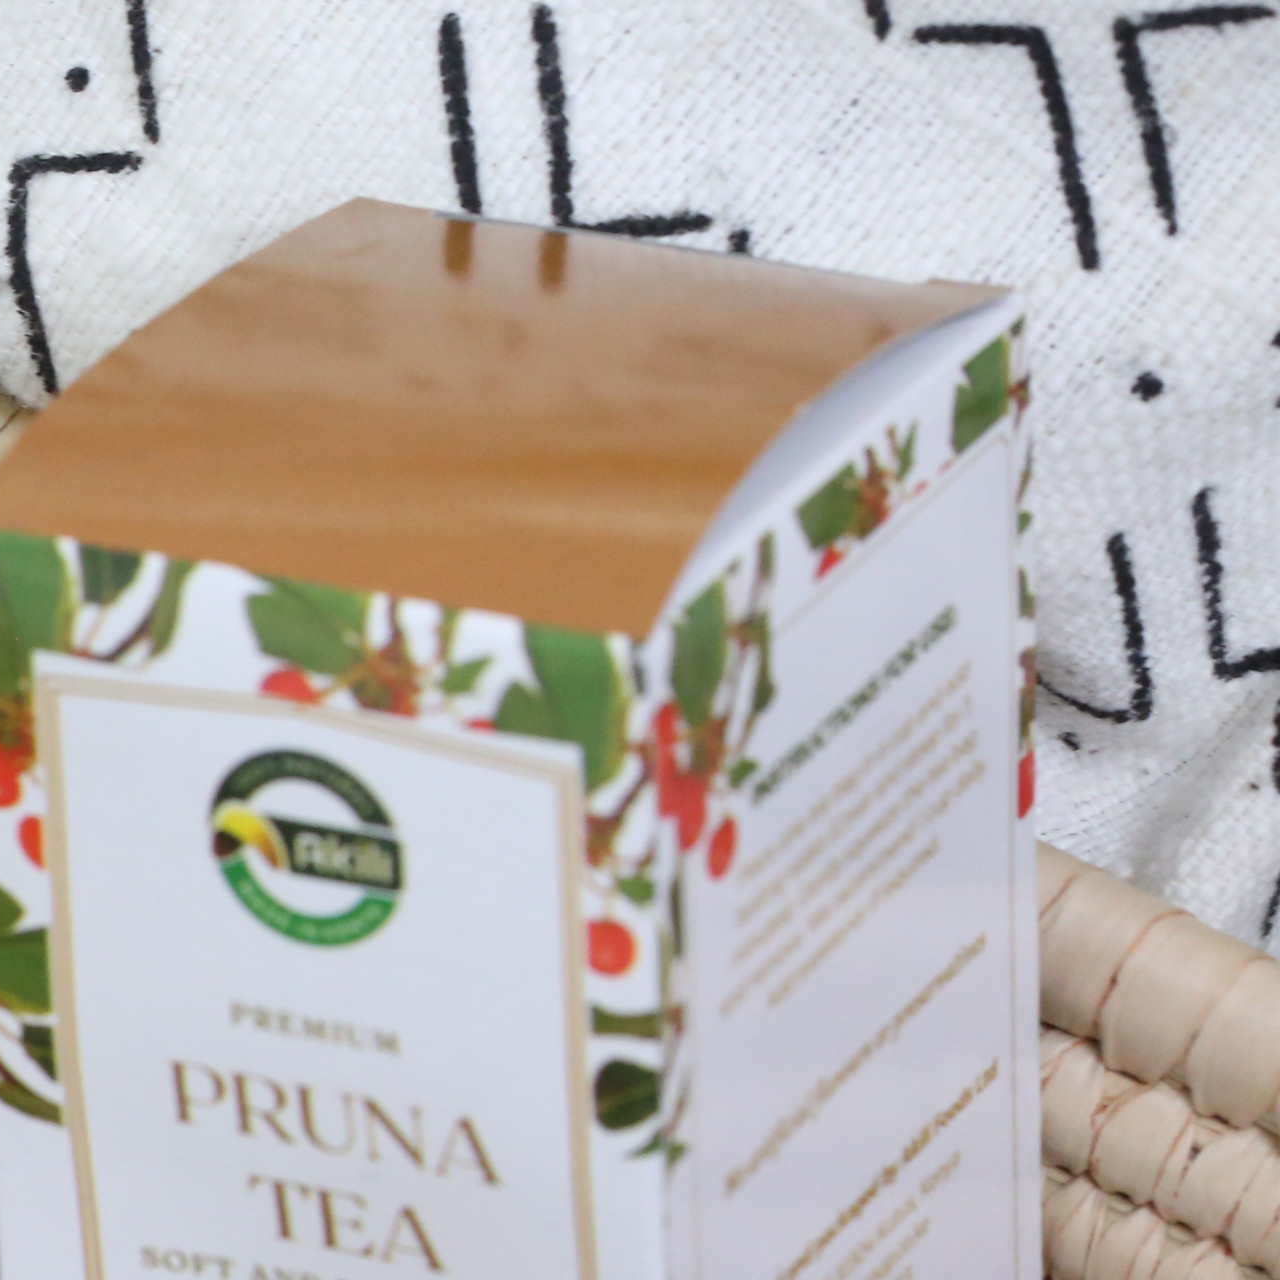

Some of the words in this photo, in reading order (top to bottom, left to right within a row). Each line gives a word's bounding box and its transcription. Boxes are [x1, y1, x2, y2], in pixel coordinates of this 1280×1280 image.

[230, 1000, 402, 1055] PREMIUM
[168, 1058, 504, 1188] PRUNA
[247, 1172, 449, 1274] TEA
[139, 1245, 236, 1280] SOFT
